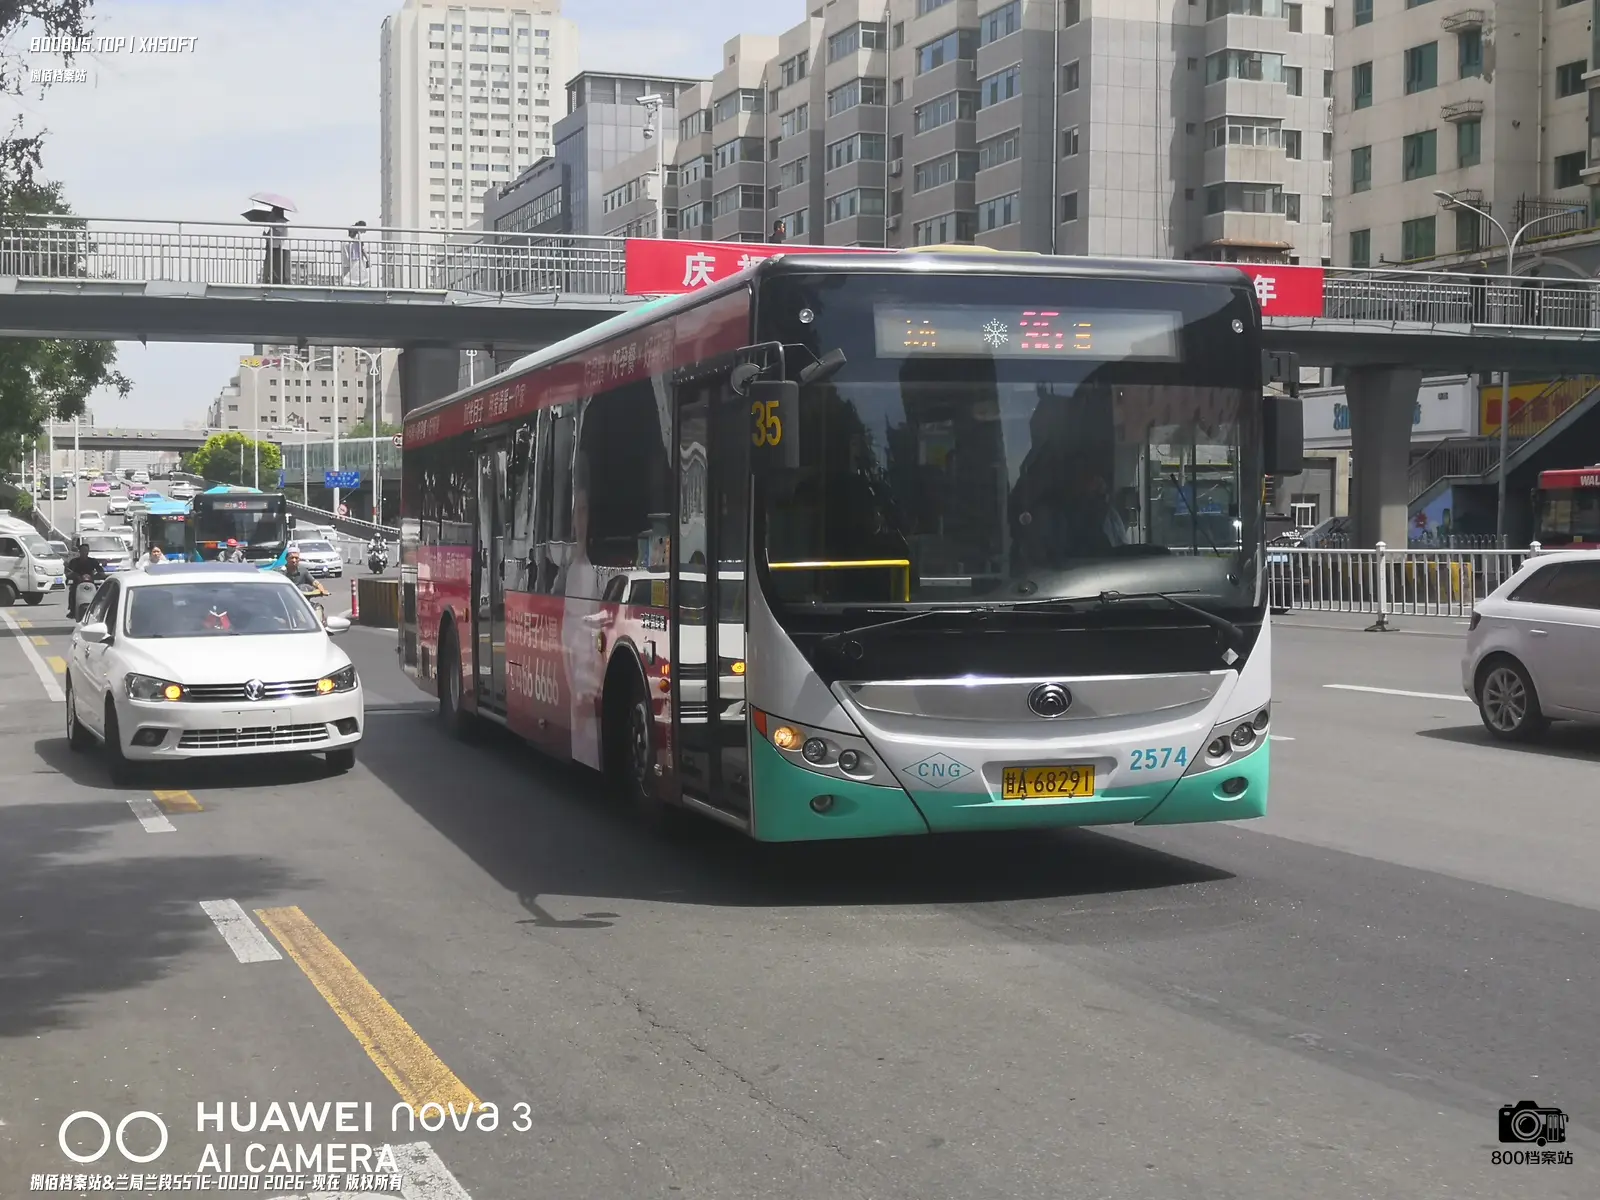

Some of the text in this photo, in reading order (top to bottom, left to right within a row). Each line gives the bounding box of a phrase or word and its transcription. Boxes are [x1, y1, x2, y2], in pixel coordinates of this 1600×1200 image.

[1253, 274, 1277, 307] 年
[751, 400, 782, 447] 35
[918, 761, 961, 778] CNG
[1130, 746, 1188, 771] 2574
